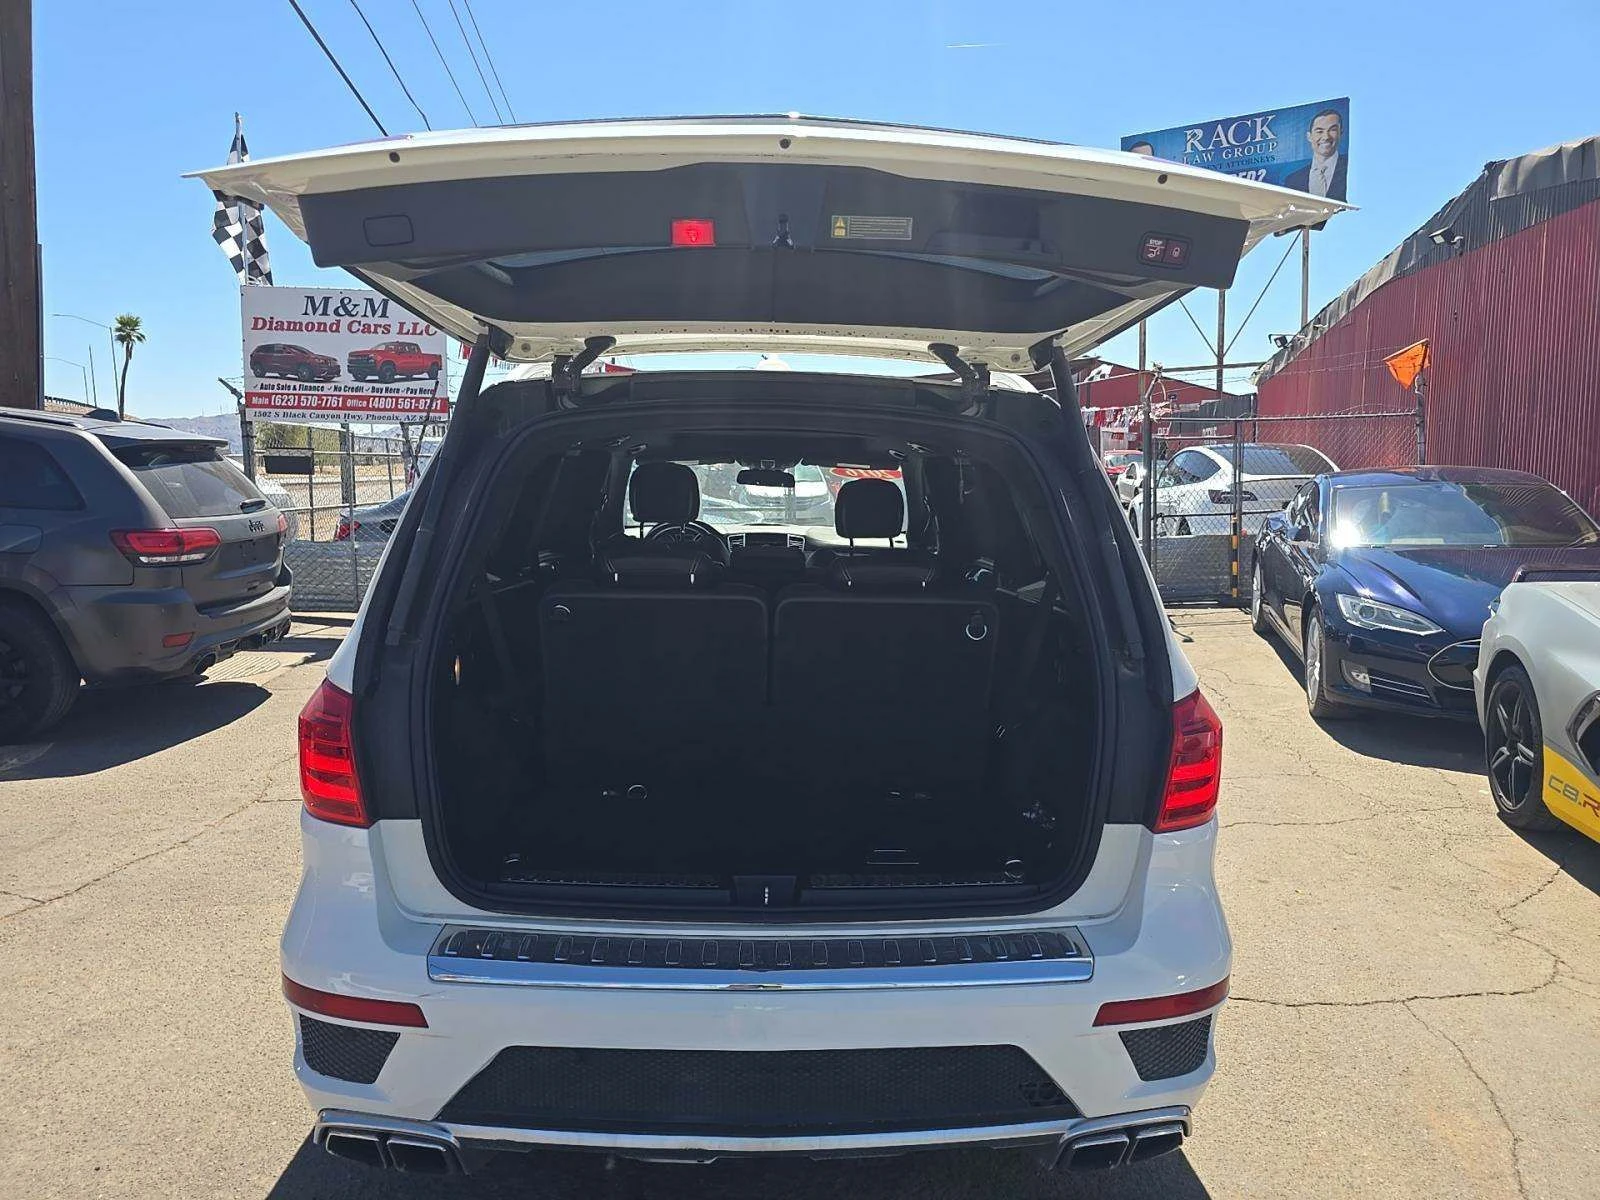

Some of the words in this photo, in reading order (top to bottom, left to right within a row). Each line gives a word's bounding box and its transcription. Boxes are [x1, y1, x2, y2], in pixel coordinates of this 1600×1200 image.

[1184, 115, 1277, 154] RACK
[1183, 151, 1214, 168] LAW
[1222, 141, 1277, 160] GROUP
[1226, 154, 1276, 169] ATTORNEYS
[301, 295, 390, 319] M&M
[251, 316, 341, 333] Diamond
[347, 320, 391, 335] Cars
[397, 321, 438, 336] LLC
[260, 382, 275, 392] Auto
[276, 383, 291, 392] Sale
[298, 384, 325, 392] Finance
[343, 385, 364, 393] Credit
[371, 386, 384, 394] Buy
[385, 386, 400, 394] Here
[405, 387, 418, 395] Pay
[251, 396, 269, 405] Main
[271, 394, 298, 406] (623)
[300, 395, 343, 407] 570-7761
[346, 400, 367, 408] Office
[369, 397, 396, 409] (480)
[282, 411, 307, 419] Black
[309, 413, 341, 421] Canyon
[404, 414, 417, 422] AZ
